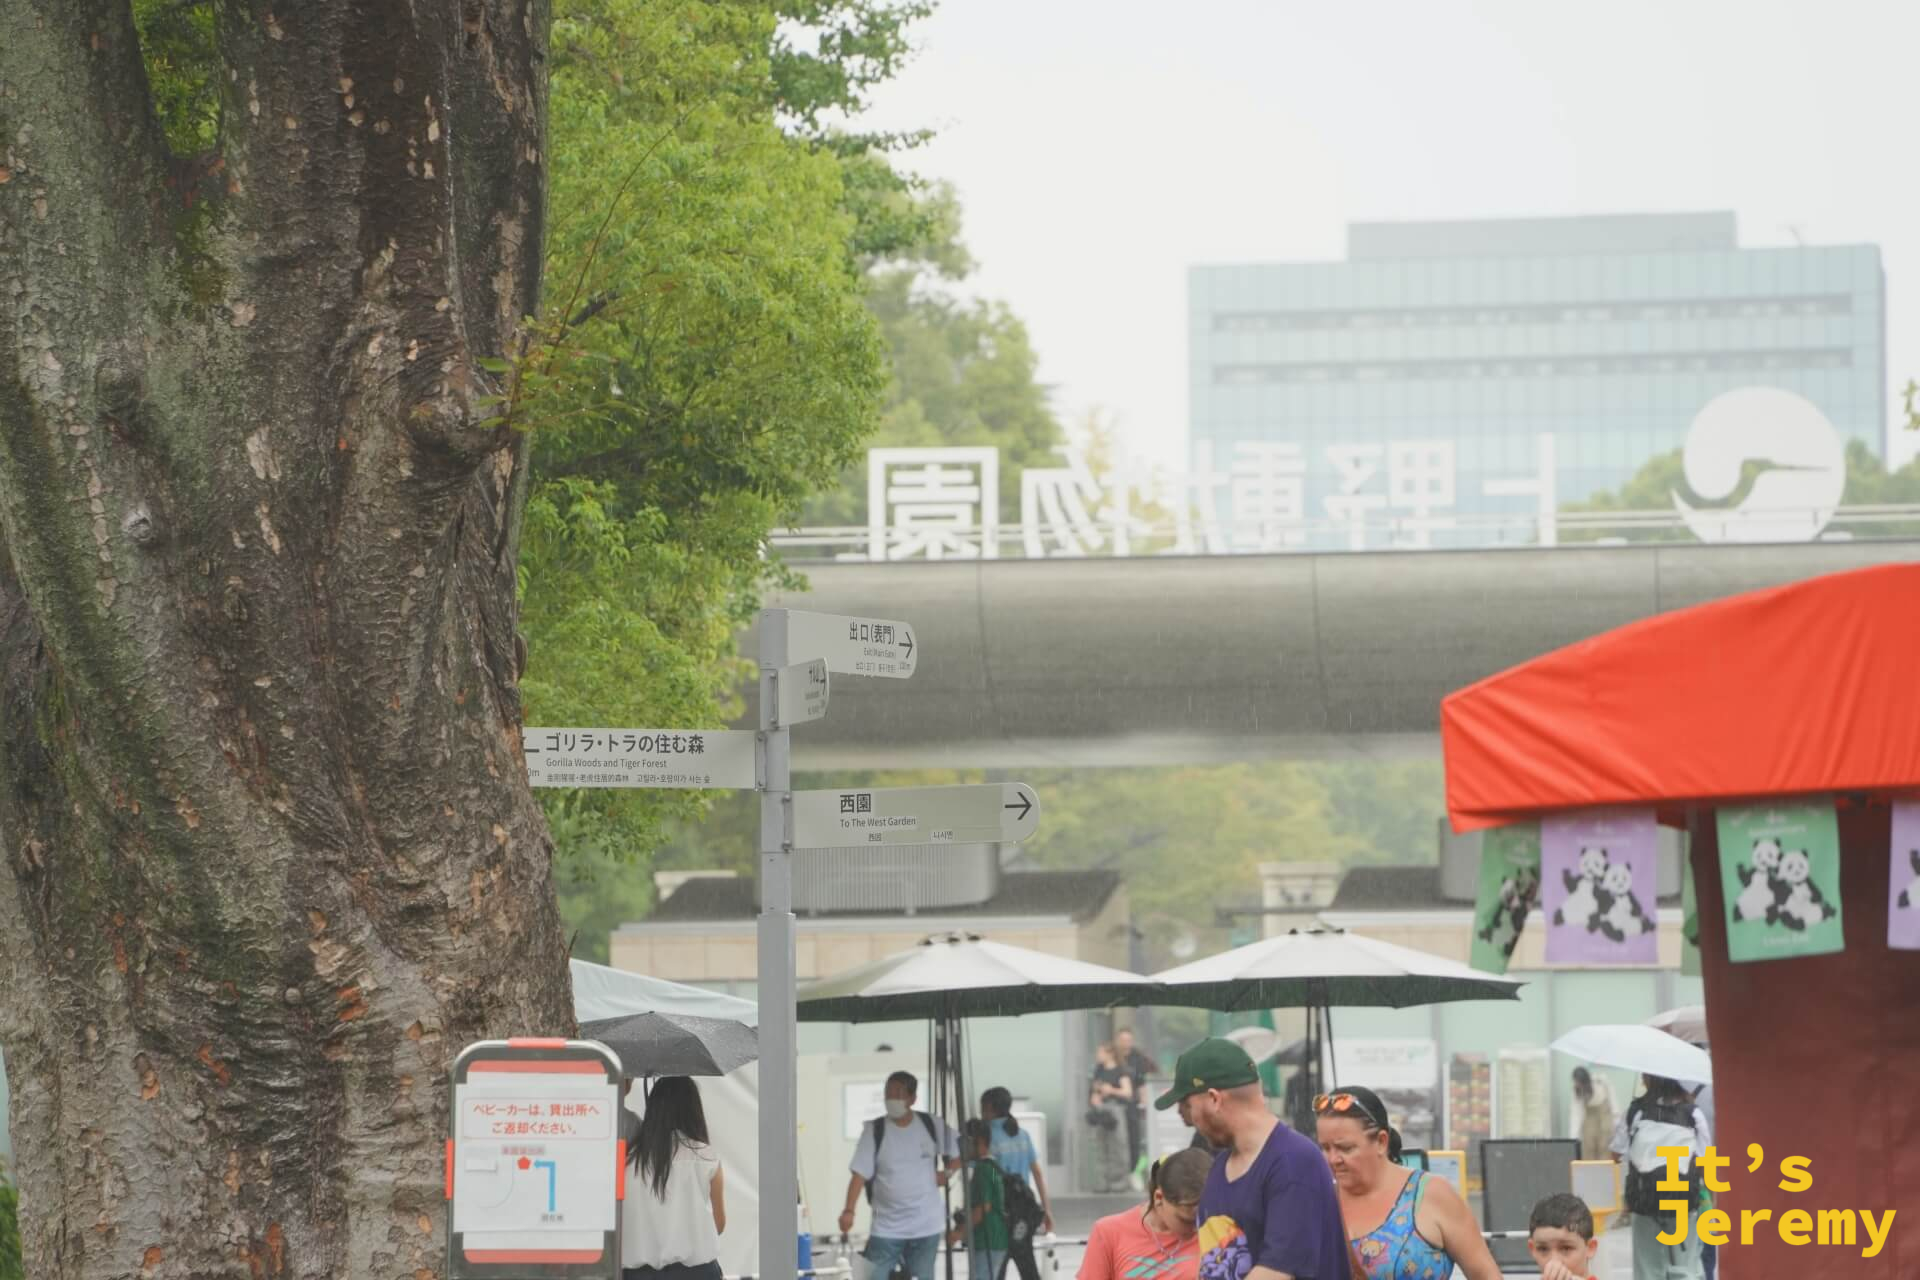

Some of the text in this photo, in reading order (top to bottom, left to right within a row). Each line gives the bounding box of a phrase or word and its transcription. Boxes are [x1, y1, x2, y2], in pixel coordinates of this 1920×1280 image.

[849, 621, 895, 645] 出口(表門)
[546, 732, 704, 755] ゴリラ・トラの住む森
[546, 758, 667, 770] Gorilla Woods and Tiger Forest
[840, 793, 872, 813] 西園
[840, 816, 916, 828] To The West Garden
